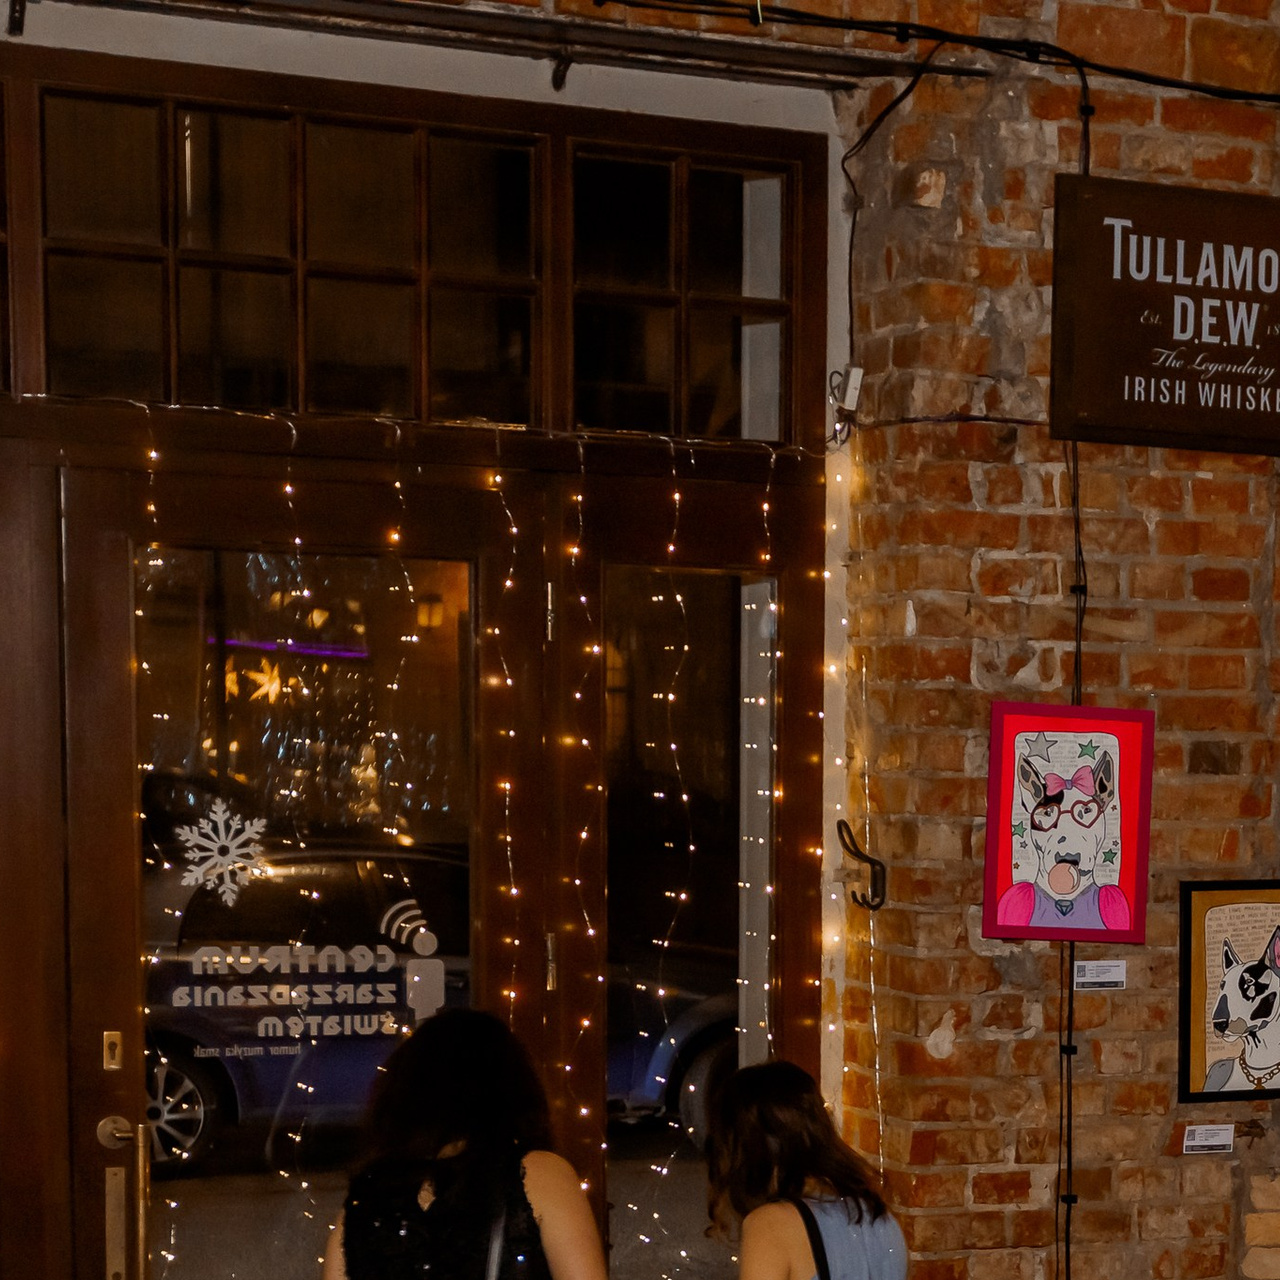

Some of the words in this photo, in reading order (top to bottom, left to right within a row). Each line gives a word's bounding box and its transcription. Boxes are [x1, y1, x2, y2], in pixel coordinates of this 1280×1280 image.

[1172, 294, 1261, 350] D.E.W.
[1152, 347, 1186, 368] The
[1188, 353, 1277, 384] Legendary
[1124, 375, 1187, 405] IRISH
